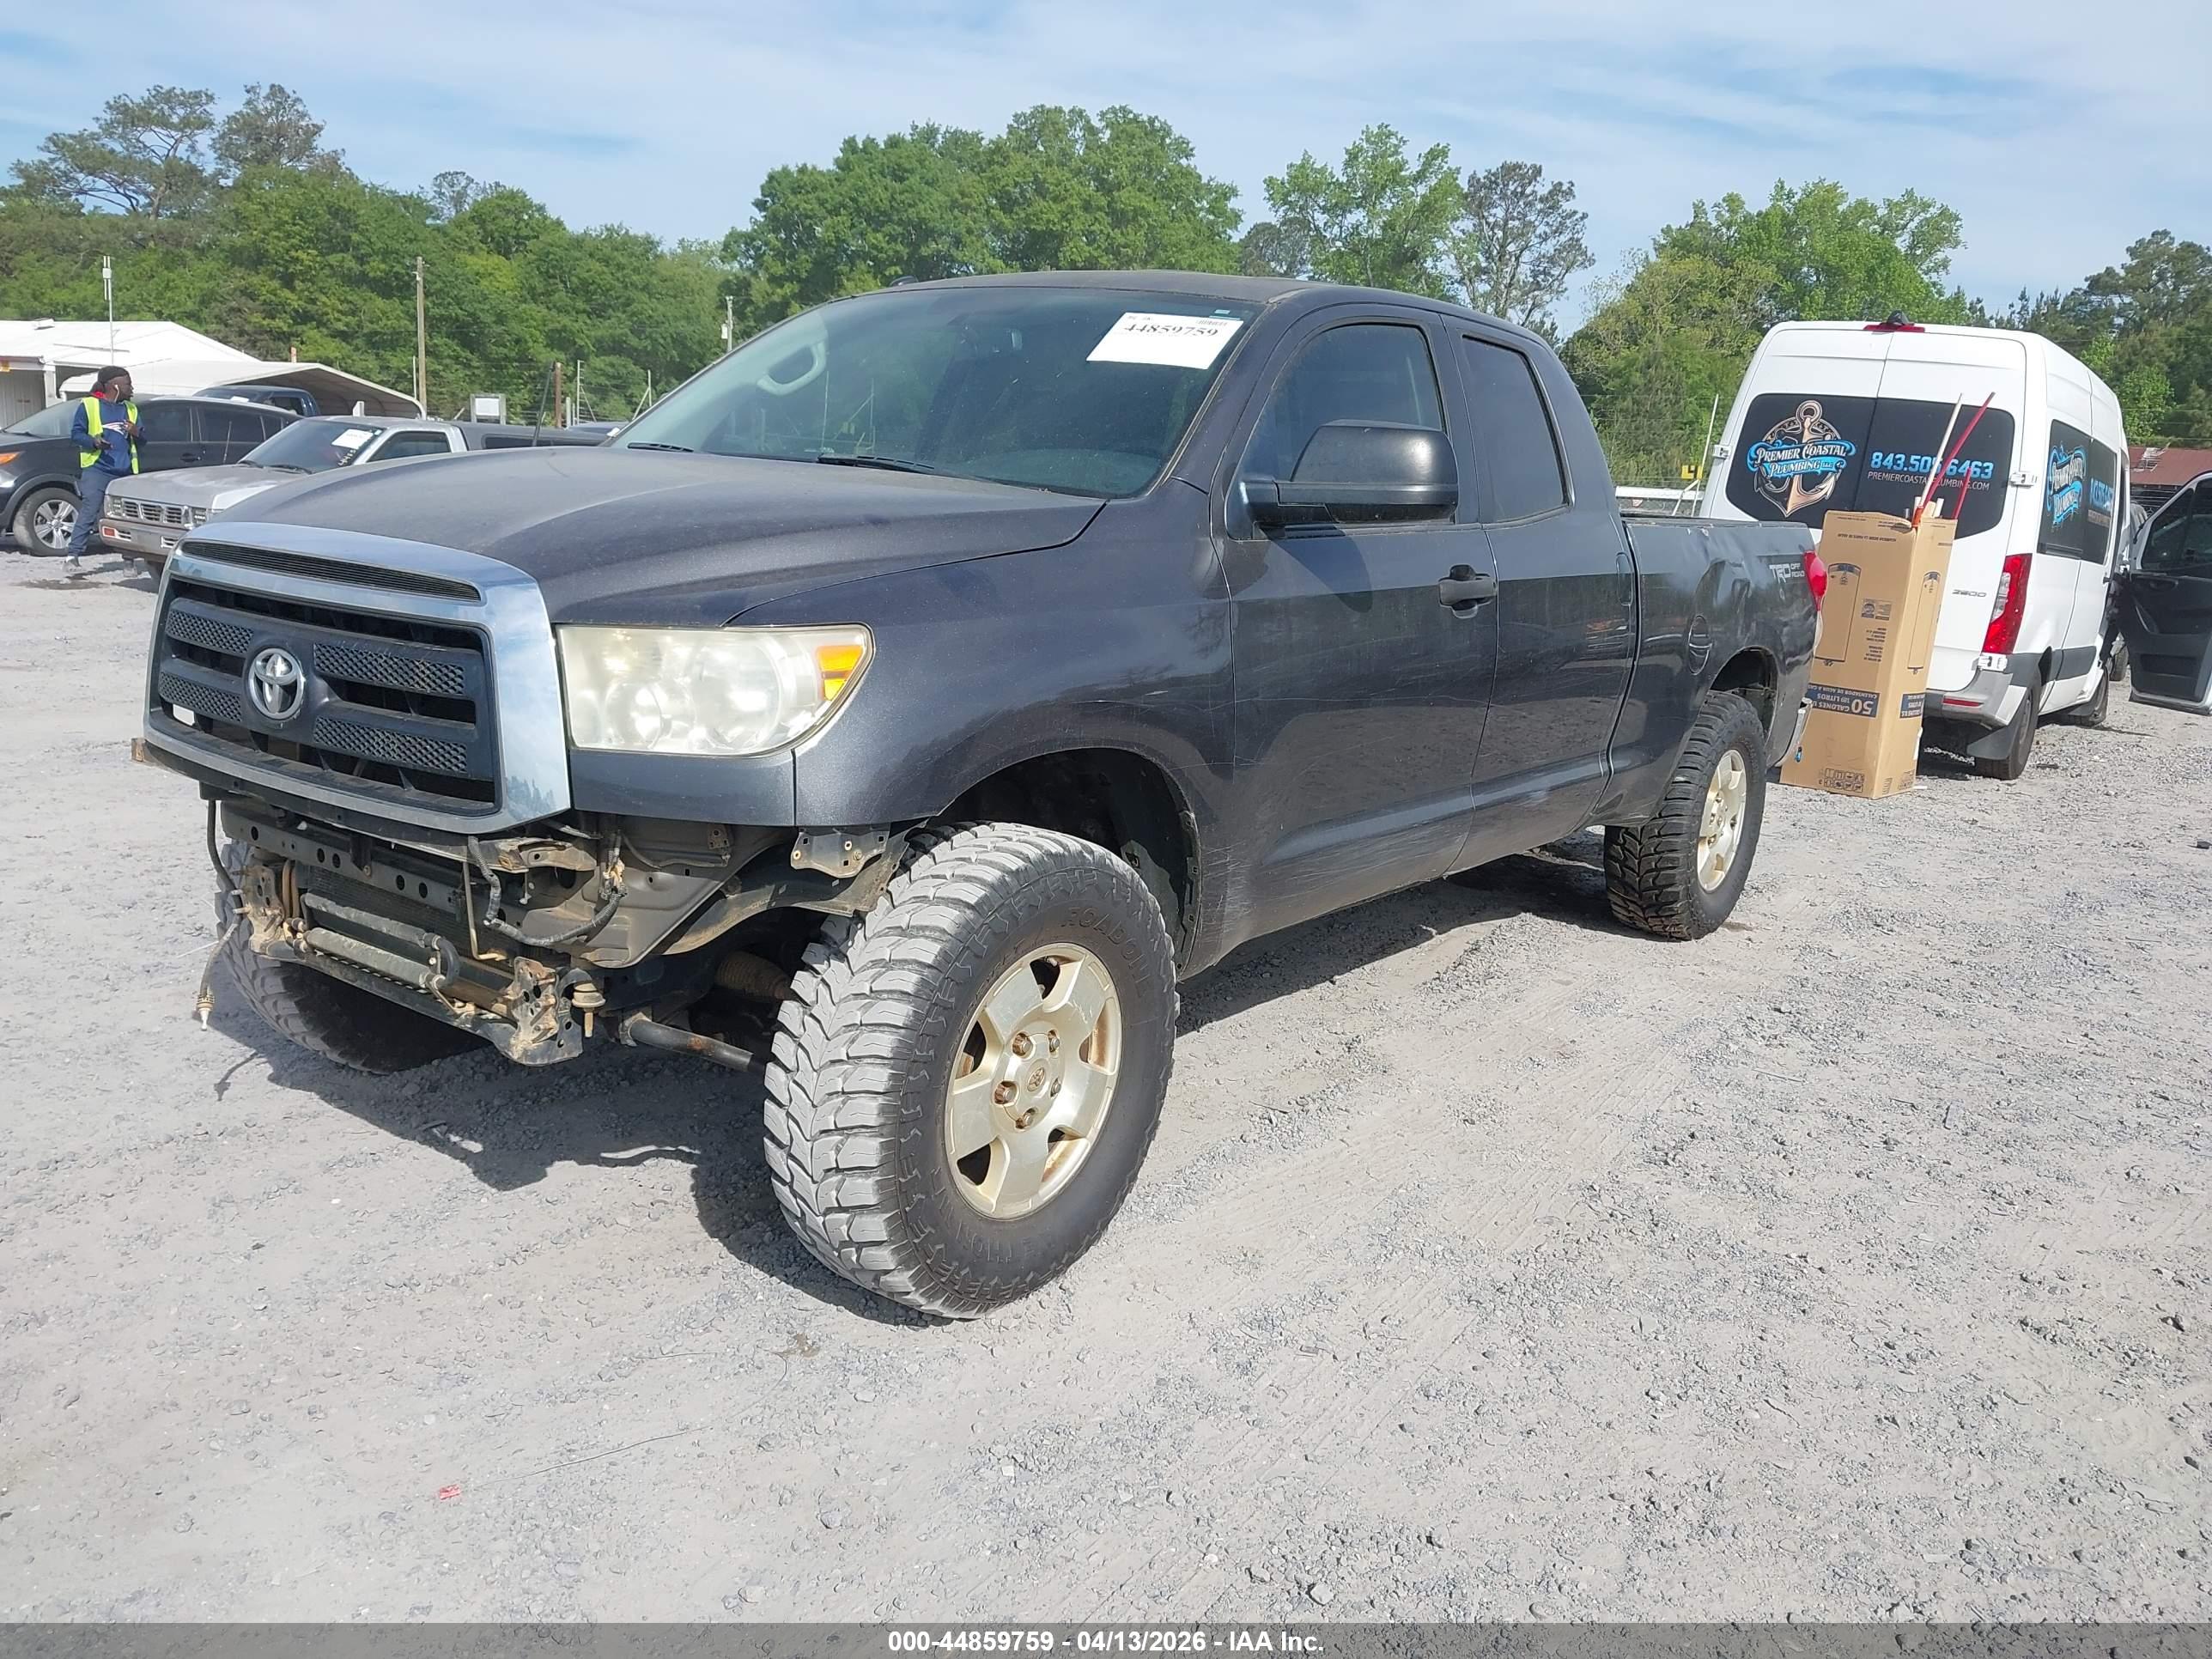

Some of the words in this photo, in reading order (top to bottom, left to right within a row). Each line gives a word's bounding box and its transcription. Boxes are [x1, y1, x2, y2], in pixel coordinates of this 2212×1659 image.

[1124, 324, 1218, 336] 44859759
[1754, 447, 1801, 464] PREMIER
[1802, 443, 1847, 459] COASTAL
[1770, 459, 1820, 477] PLUMBING
[1870, 452, 1994, 479] 843.5056463
[1868, 471, 1990, 490] PREMIERCOASTAUMBIN.COM
[1769, 562, 1791, 584] TRD
[1817, 693, 1840, 702] LITROS
[1851, 699, 1874, 715] 50
